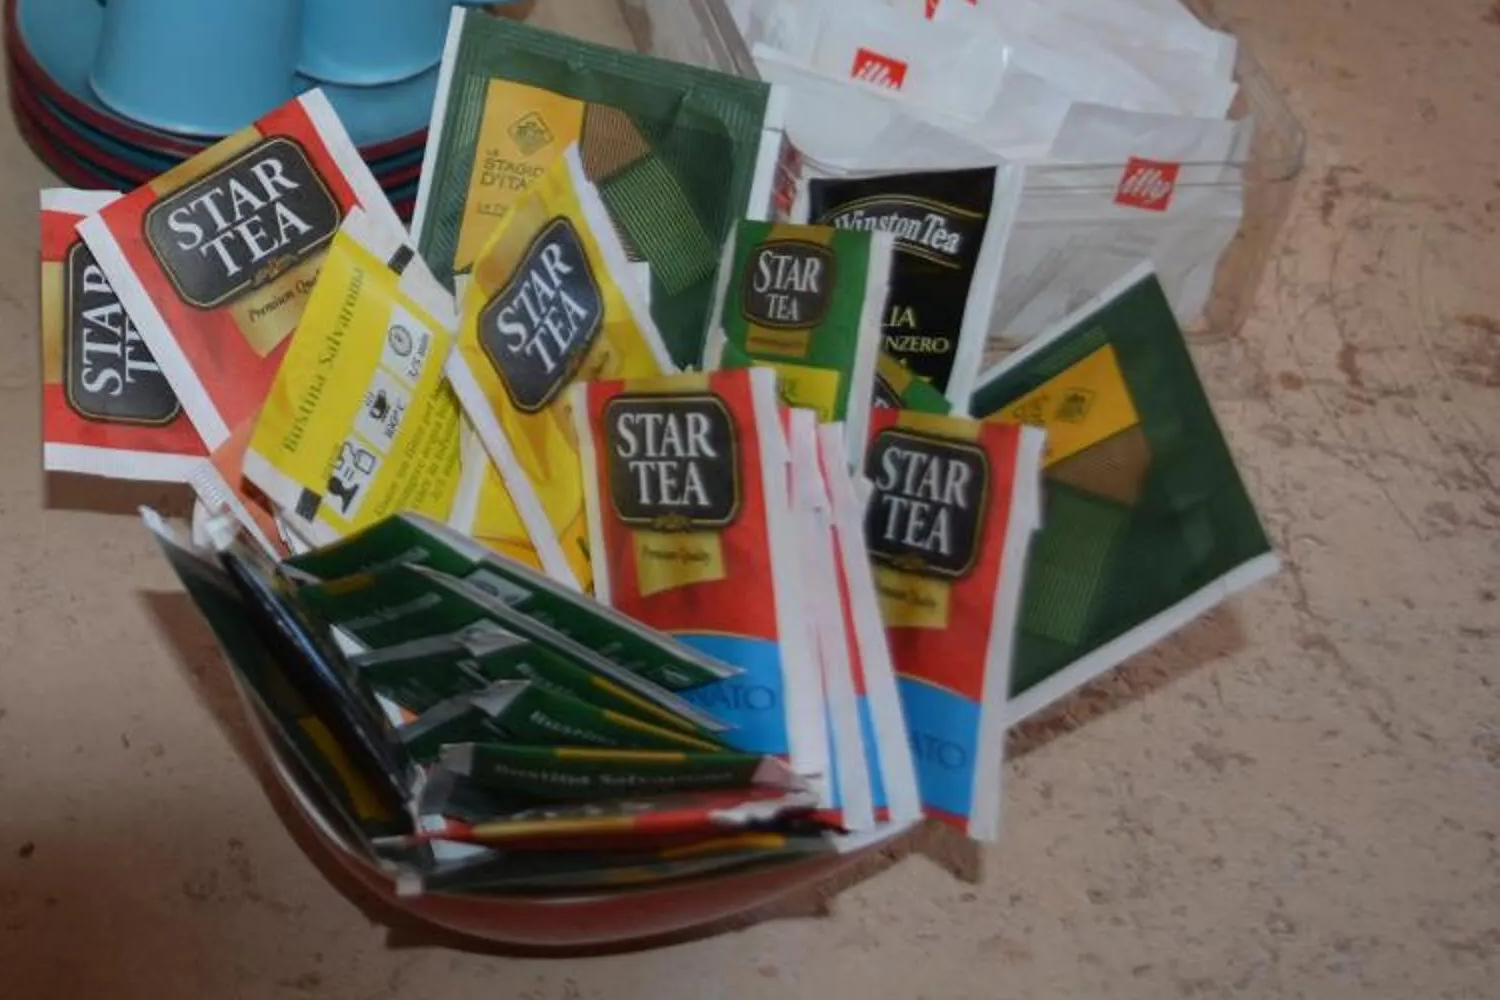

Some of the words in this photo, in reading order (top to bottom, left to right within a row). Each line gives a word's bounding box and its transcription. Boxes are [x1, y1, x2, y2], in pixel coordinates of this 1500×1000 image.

[167, 157, 299, 251] STAR
[920, 212, 965, 255] Tea
[200, 202, 314, 278] TEA
[497, 242, 574, 353] STAR
[753, 250, 823, 294] STAR
[525, 289, 588, 374] TEA
[766, 293, 800, 321] TEA
[883, 334, 950, 353] NZERO
[281, 371, 326, 454] Bustina
[615, 412, 718, 459] STAR
[628, 459, 713, 506] TEA
[875, 445, 973, 509] STAR
[882, 494, 954, 556] TEA
